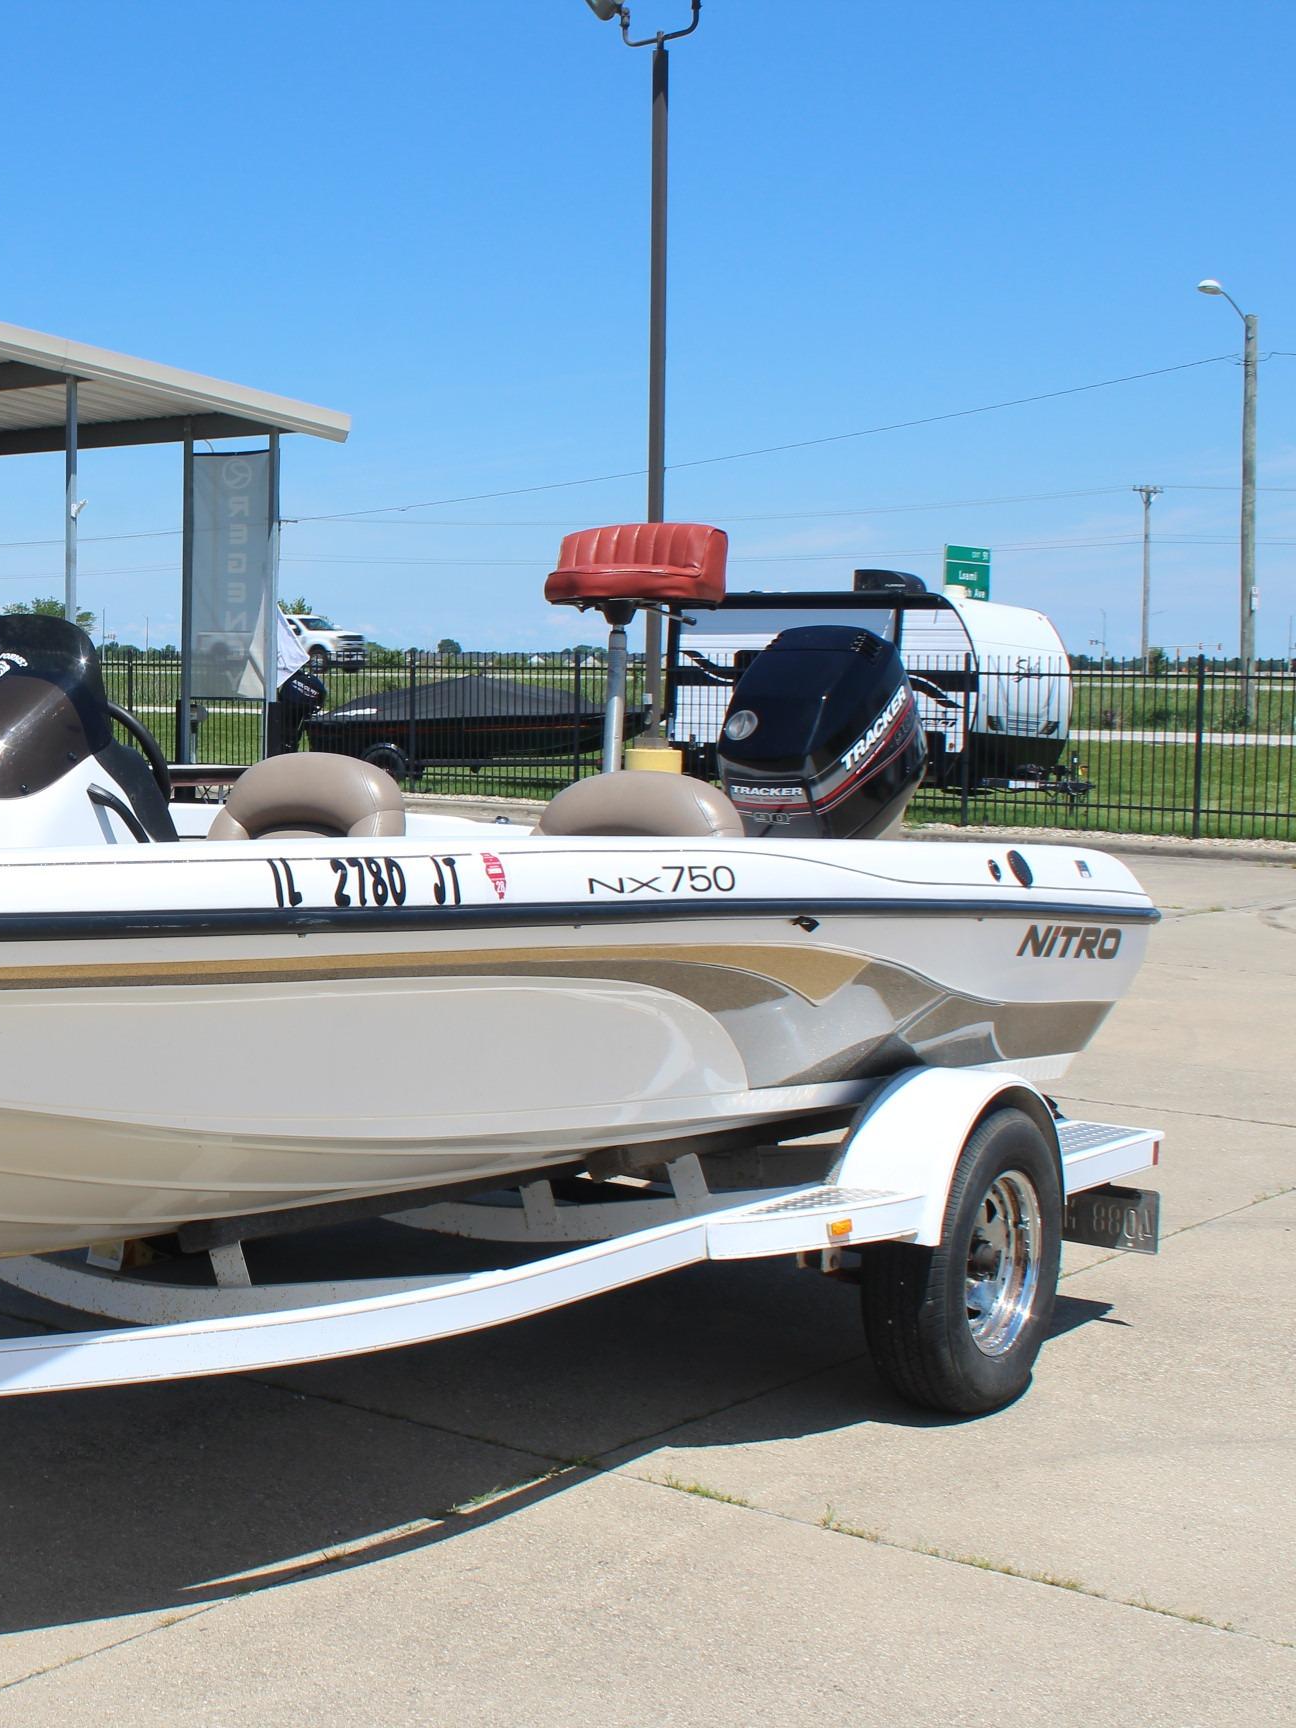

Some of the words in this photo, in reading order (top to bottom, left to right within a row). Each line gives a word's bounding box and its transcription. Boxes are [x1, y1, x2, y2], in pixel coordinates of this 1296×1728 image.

[840, 685, 907, 771] TRACKER
[731, 785, 803, 796] TRACKER
[266, 857, 303, 908] IL
[331, 856, 406, 907] 2780
